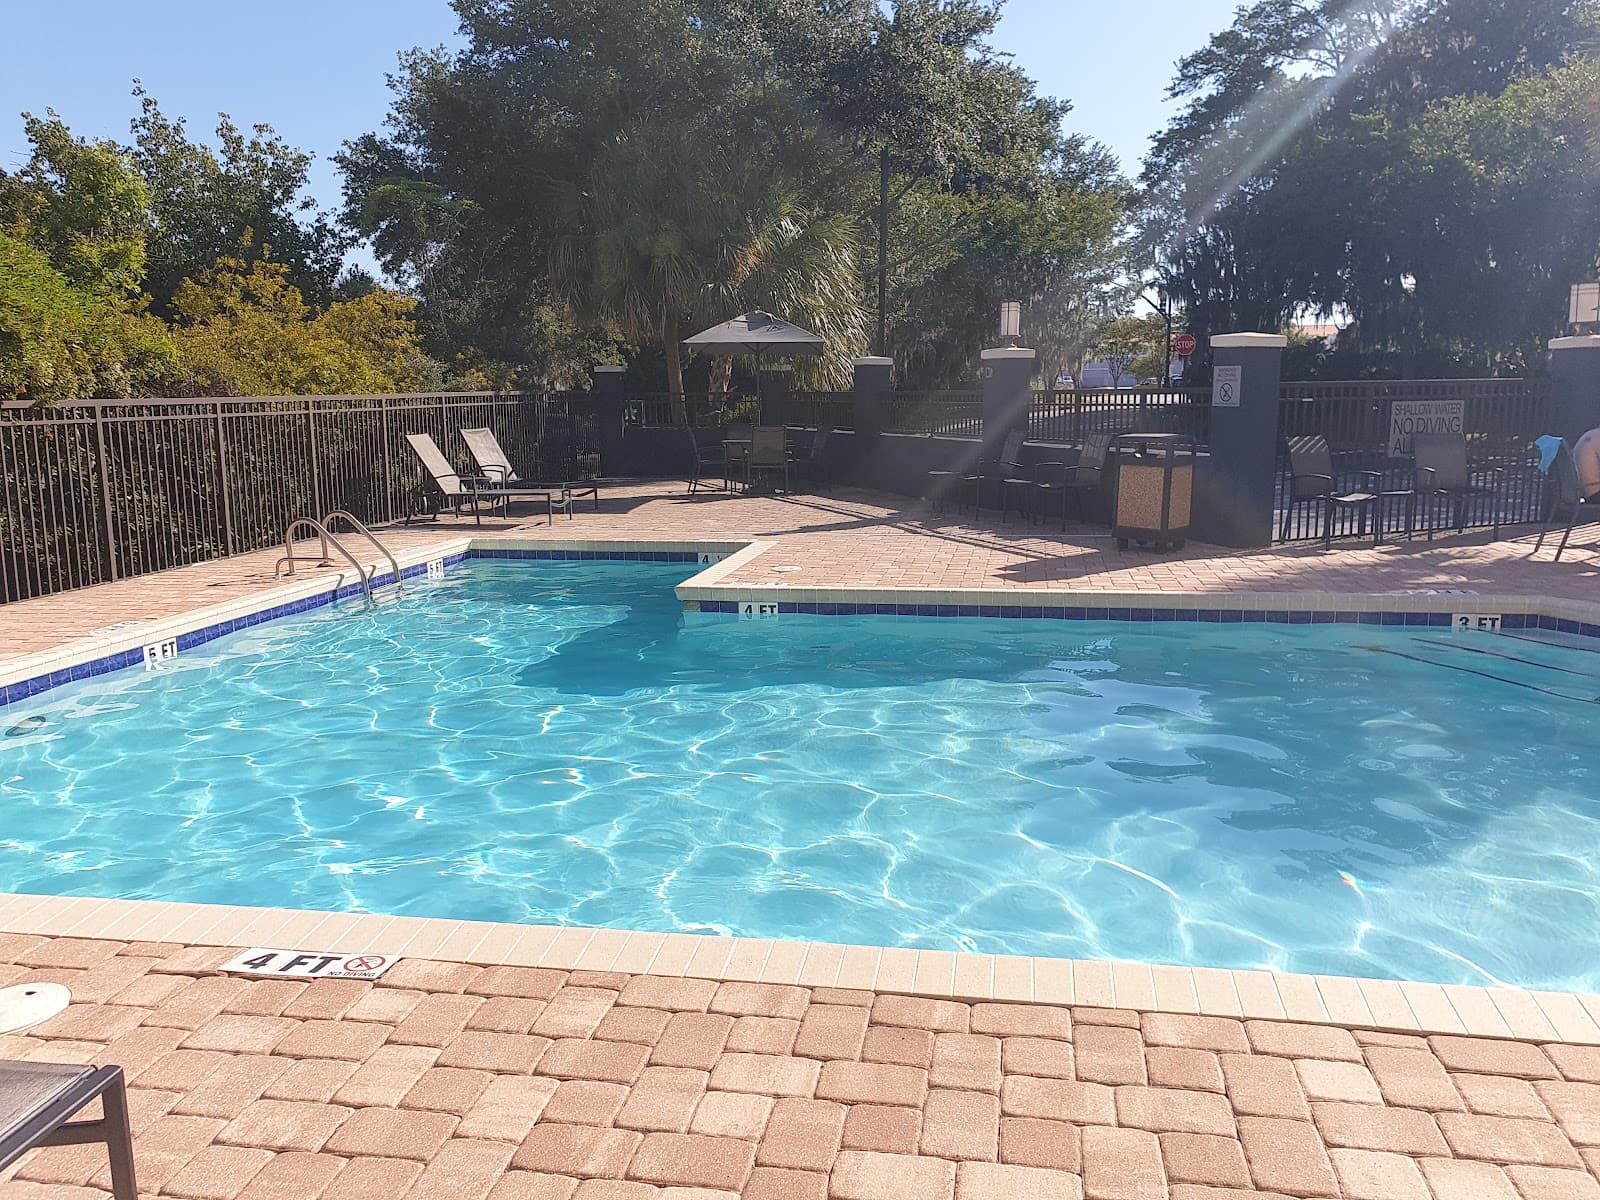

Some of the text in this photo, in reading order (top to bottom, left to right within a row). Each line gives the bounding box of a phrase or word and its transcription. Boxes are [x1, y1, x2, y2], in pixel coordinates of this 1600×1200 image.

[1177, 341, 1194, 349] STOP
[1394, 402, 1461, 416] SHALLOW WATER
[1393, 416, 1460, 434] NO DIVING
[702, 555, 709, 563] 4
[759, 604, 777, 619] FT
[1478, 617, 1500, 629] FT
[161, 641, 176, 659] FT
[242, 953, 342, 974] 4 FT
